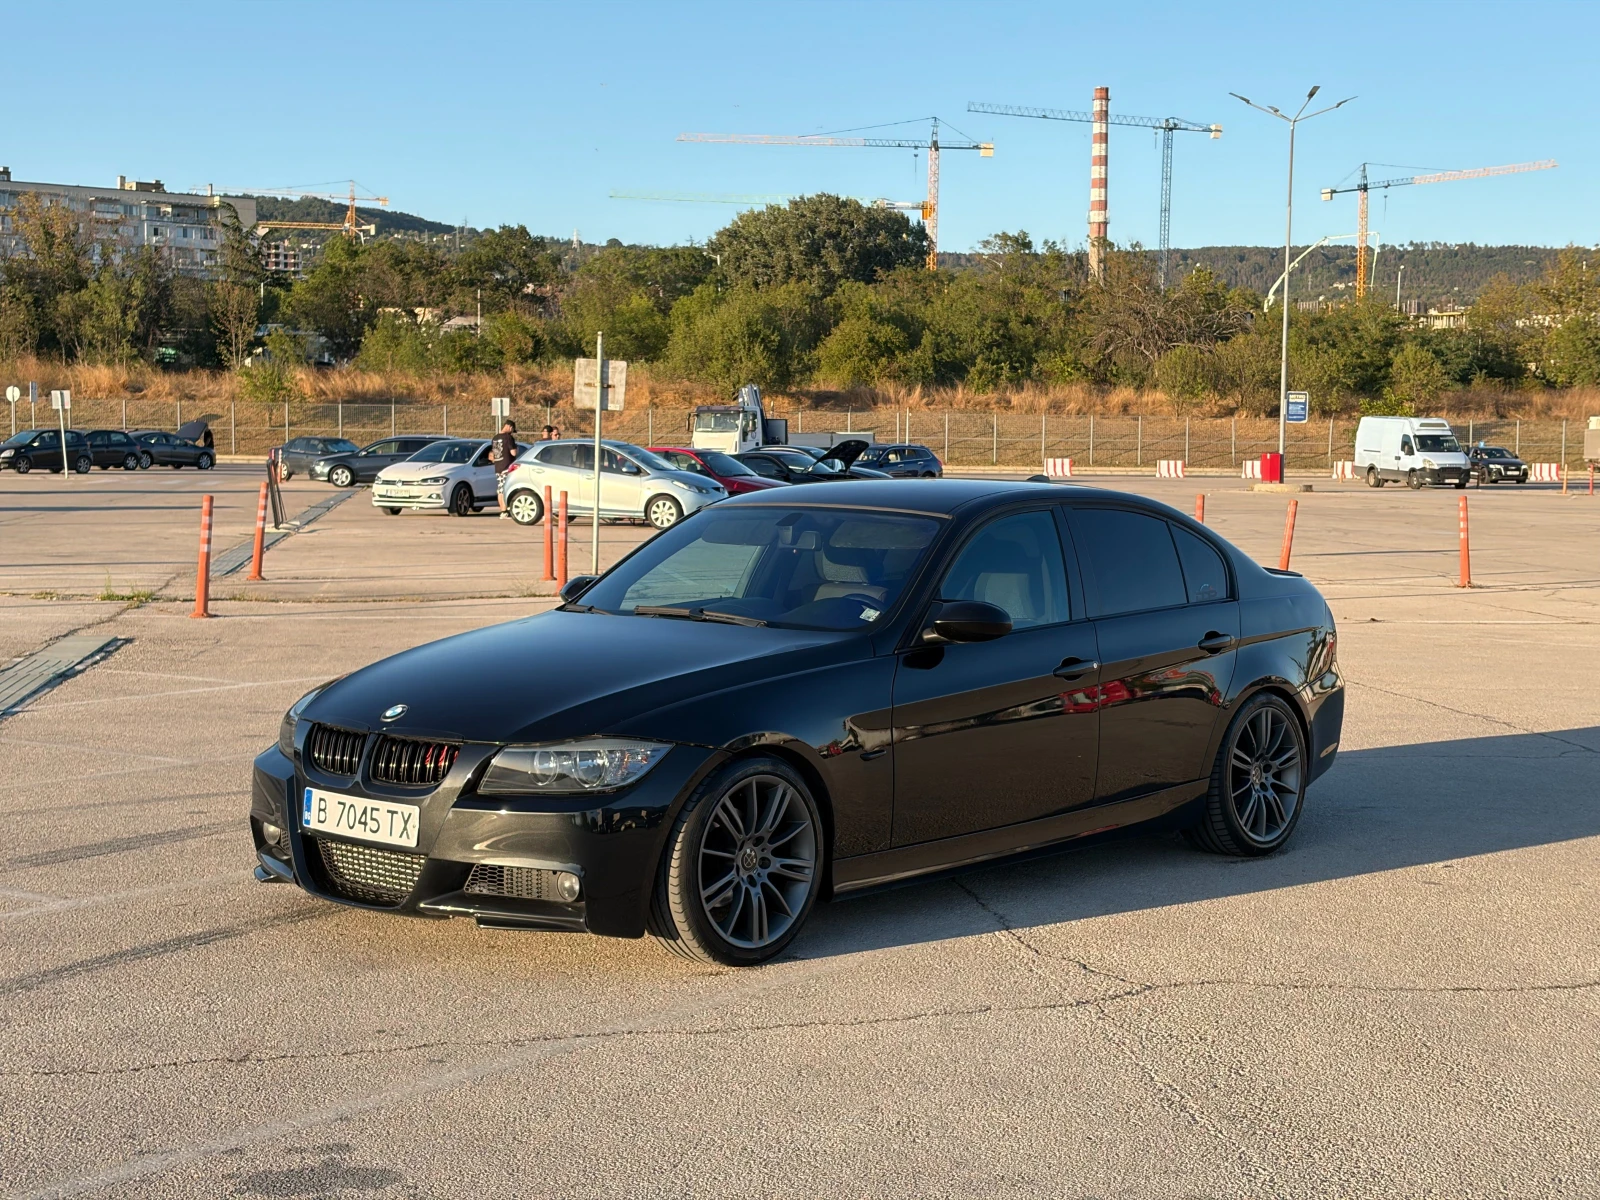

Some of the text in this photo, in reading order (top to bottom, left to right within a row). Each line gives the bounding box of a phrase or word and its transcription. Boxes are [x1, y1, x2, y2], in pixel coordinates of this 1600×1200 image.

[317, 797, 412, 840] B 7045 TX
